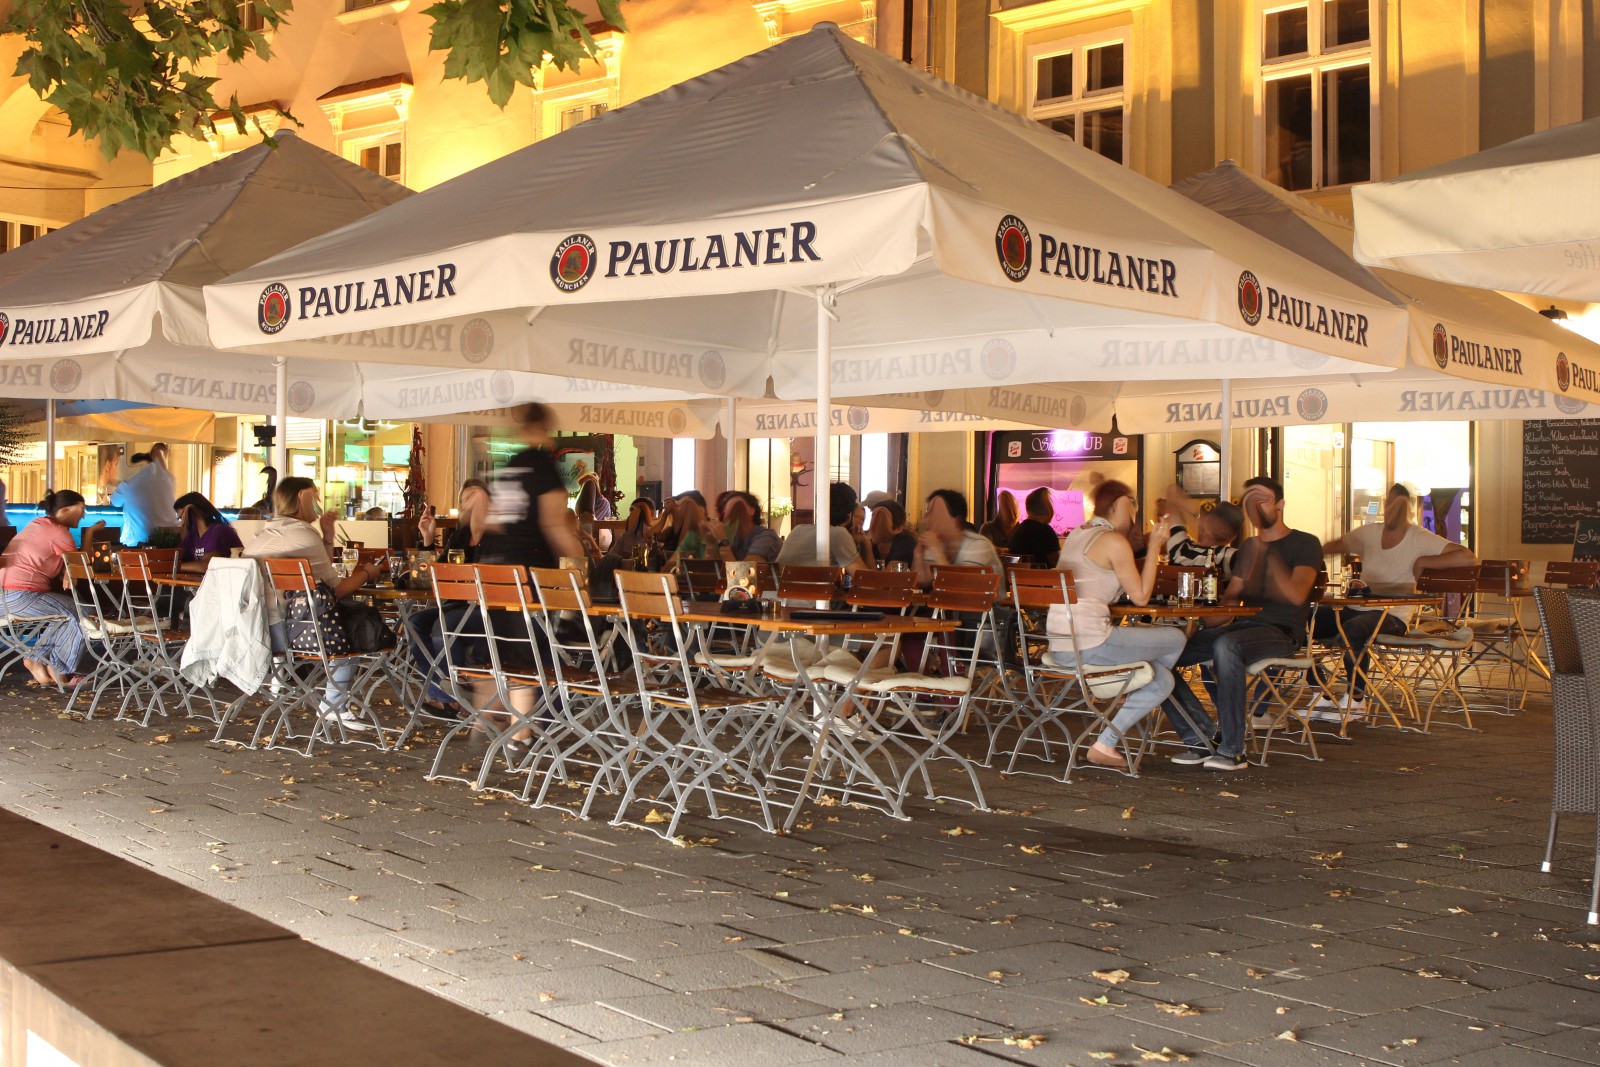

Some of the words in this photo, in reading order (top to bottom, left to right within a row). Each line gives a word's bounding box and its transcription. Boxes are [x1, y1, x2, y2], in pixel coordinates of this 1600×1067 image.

[998, 217, 1030, 243] PAULANER
[555, 236, 595, 258] PAULANER
[605, 221, 822, 278] PAULANER
[1002, 260, 1028, 279] MÜNCHEN
[1039, 233, 1179, 298] PAULANER
[260, 284, 288, 305] PAULANER
[297, 263, 458, 320] PAULANER
[554, 275, 588, 291] MÜNCHEN
[1239, 272, 1260, 294] PAULANER
[9, 309, 109, 345] PAULANER
[1266, 286, 1368, 347] PAULANER
[1450, 334, 1523, 375] PAULANER
[1571, 362, 1600, 393] PAUL
